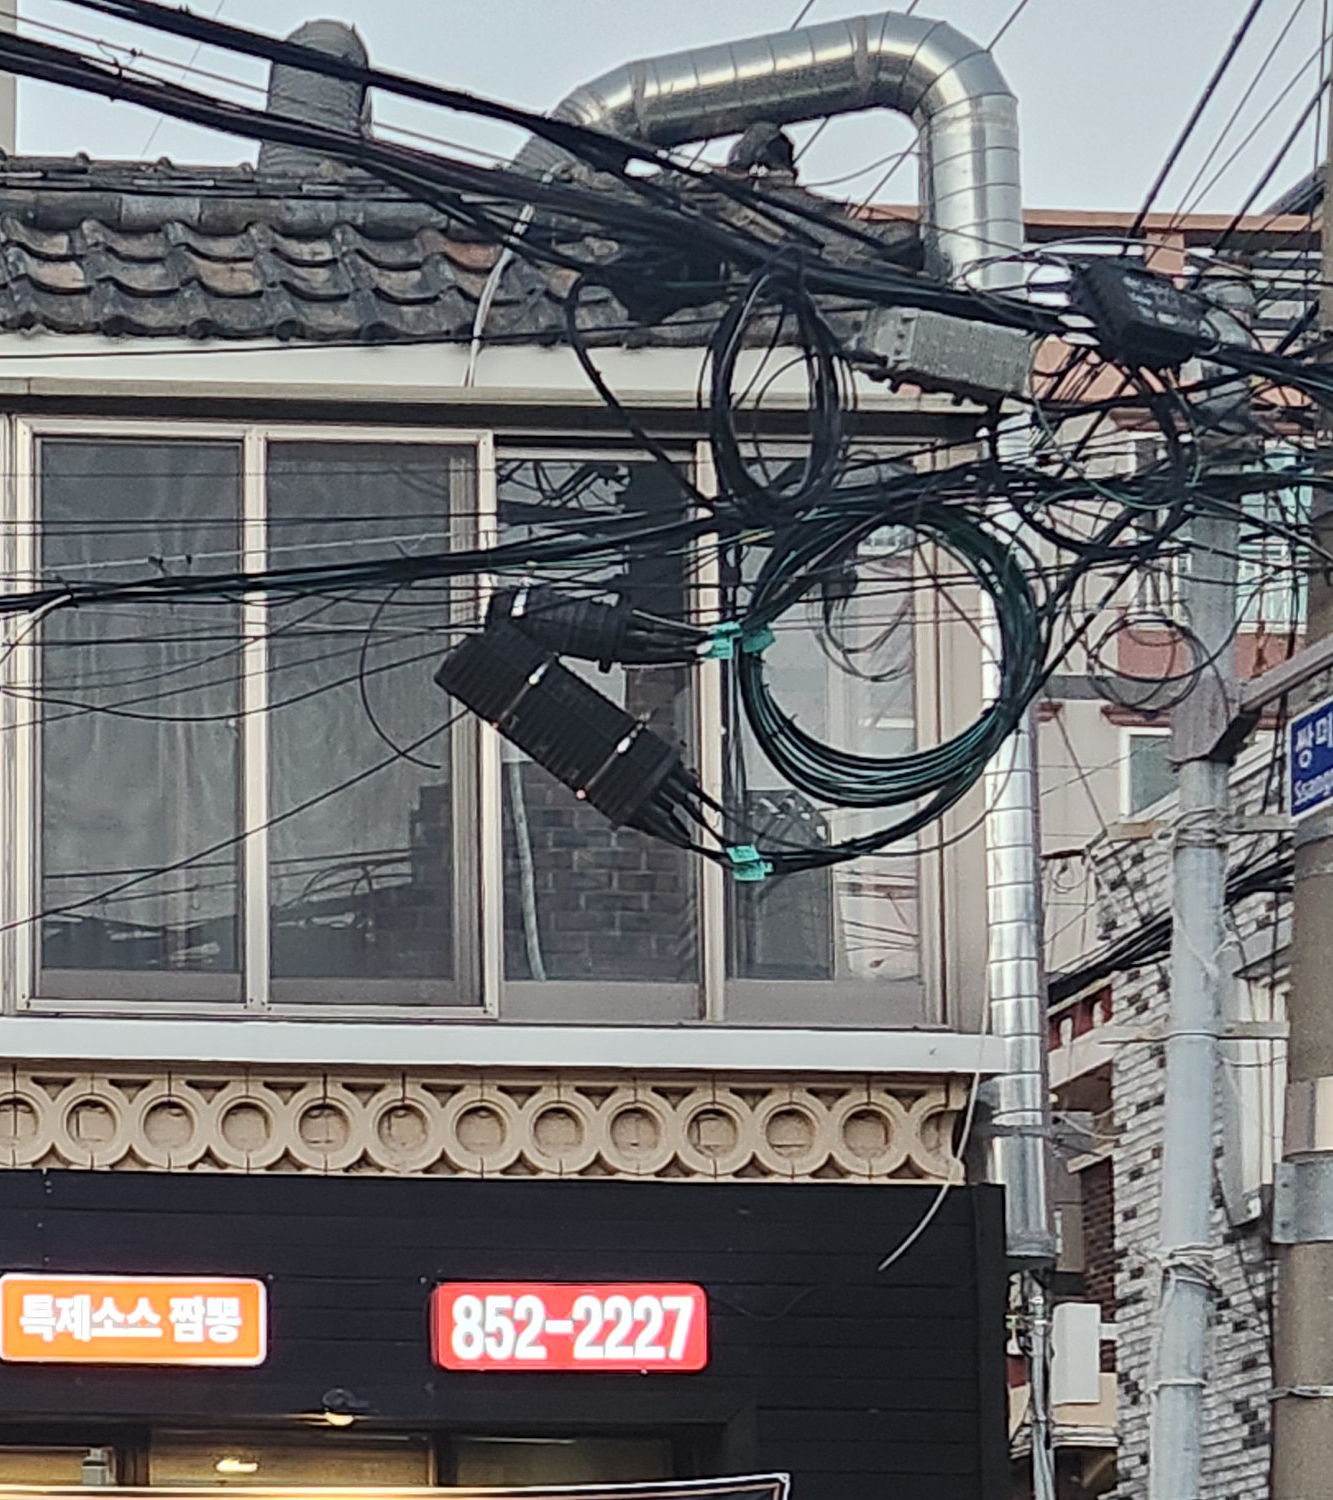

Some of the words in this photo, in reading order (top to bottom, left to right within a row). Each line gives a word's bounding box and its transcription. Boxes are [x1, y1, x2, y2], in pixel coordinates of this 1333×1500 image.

[19, 1294, 163, 1342] 특제소스
[168, 1295, 243, 1343] 짬뽕
[451, 1294, 695, 1360] 852-2227
